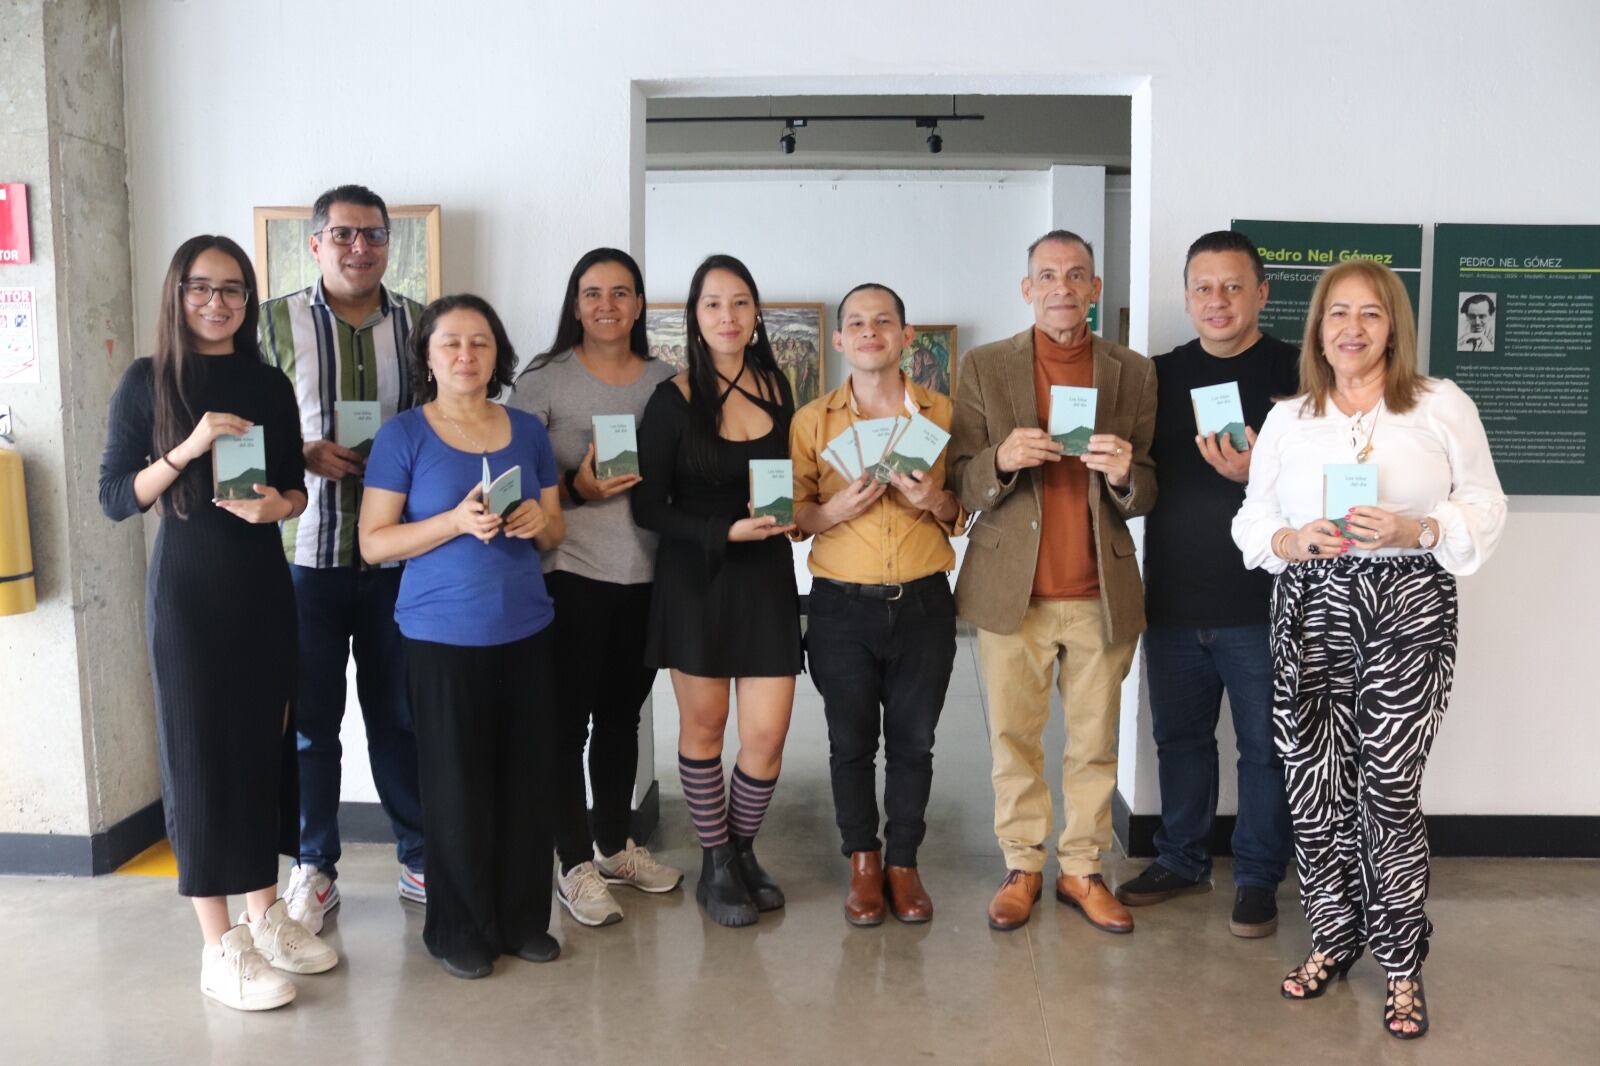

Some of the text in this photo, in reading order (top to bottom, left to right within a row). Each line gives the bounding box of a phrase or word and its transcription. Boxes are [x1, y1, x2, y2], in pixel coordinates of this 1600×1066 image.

[1257, 247, 1393, 264] Pedro Nel Gómez
[1459, 255, 1562, 268] PEDRO NEL GÓMEZ
[1264, 271, 1321, 281] anifestacio
